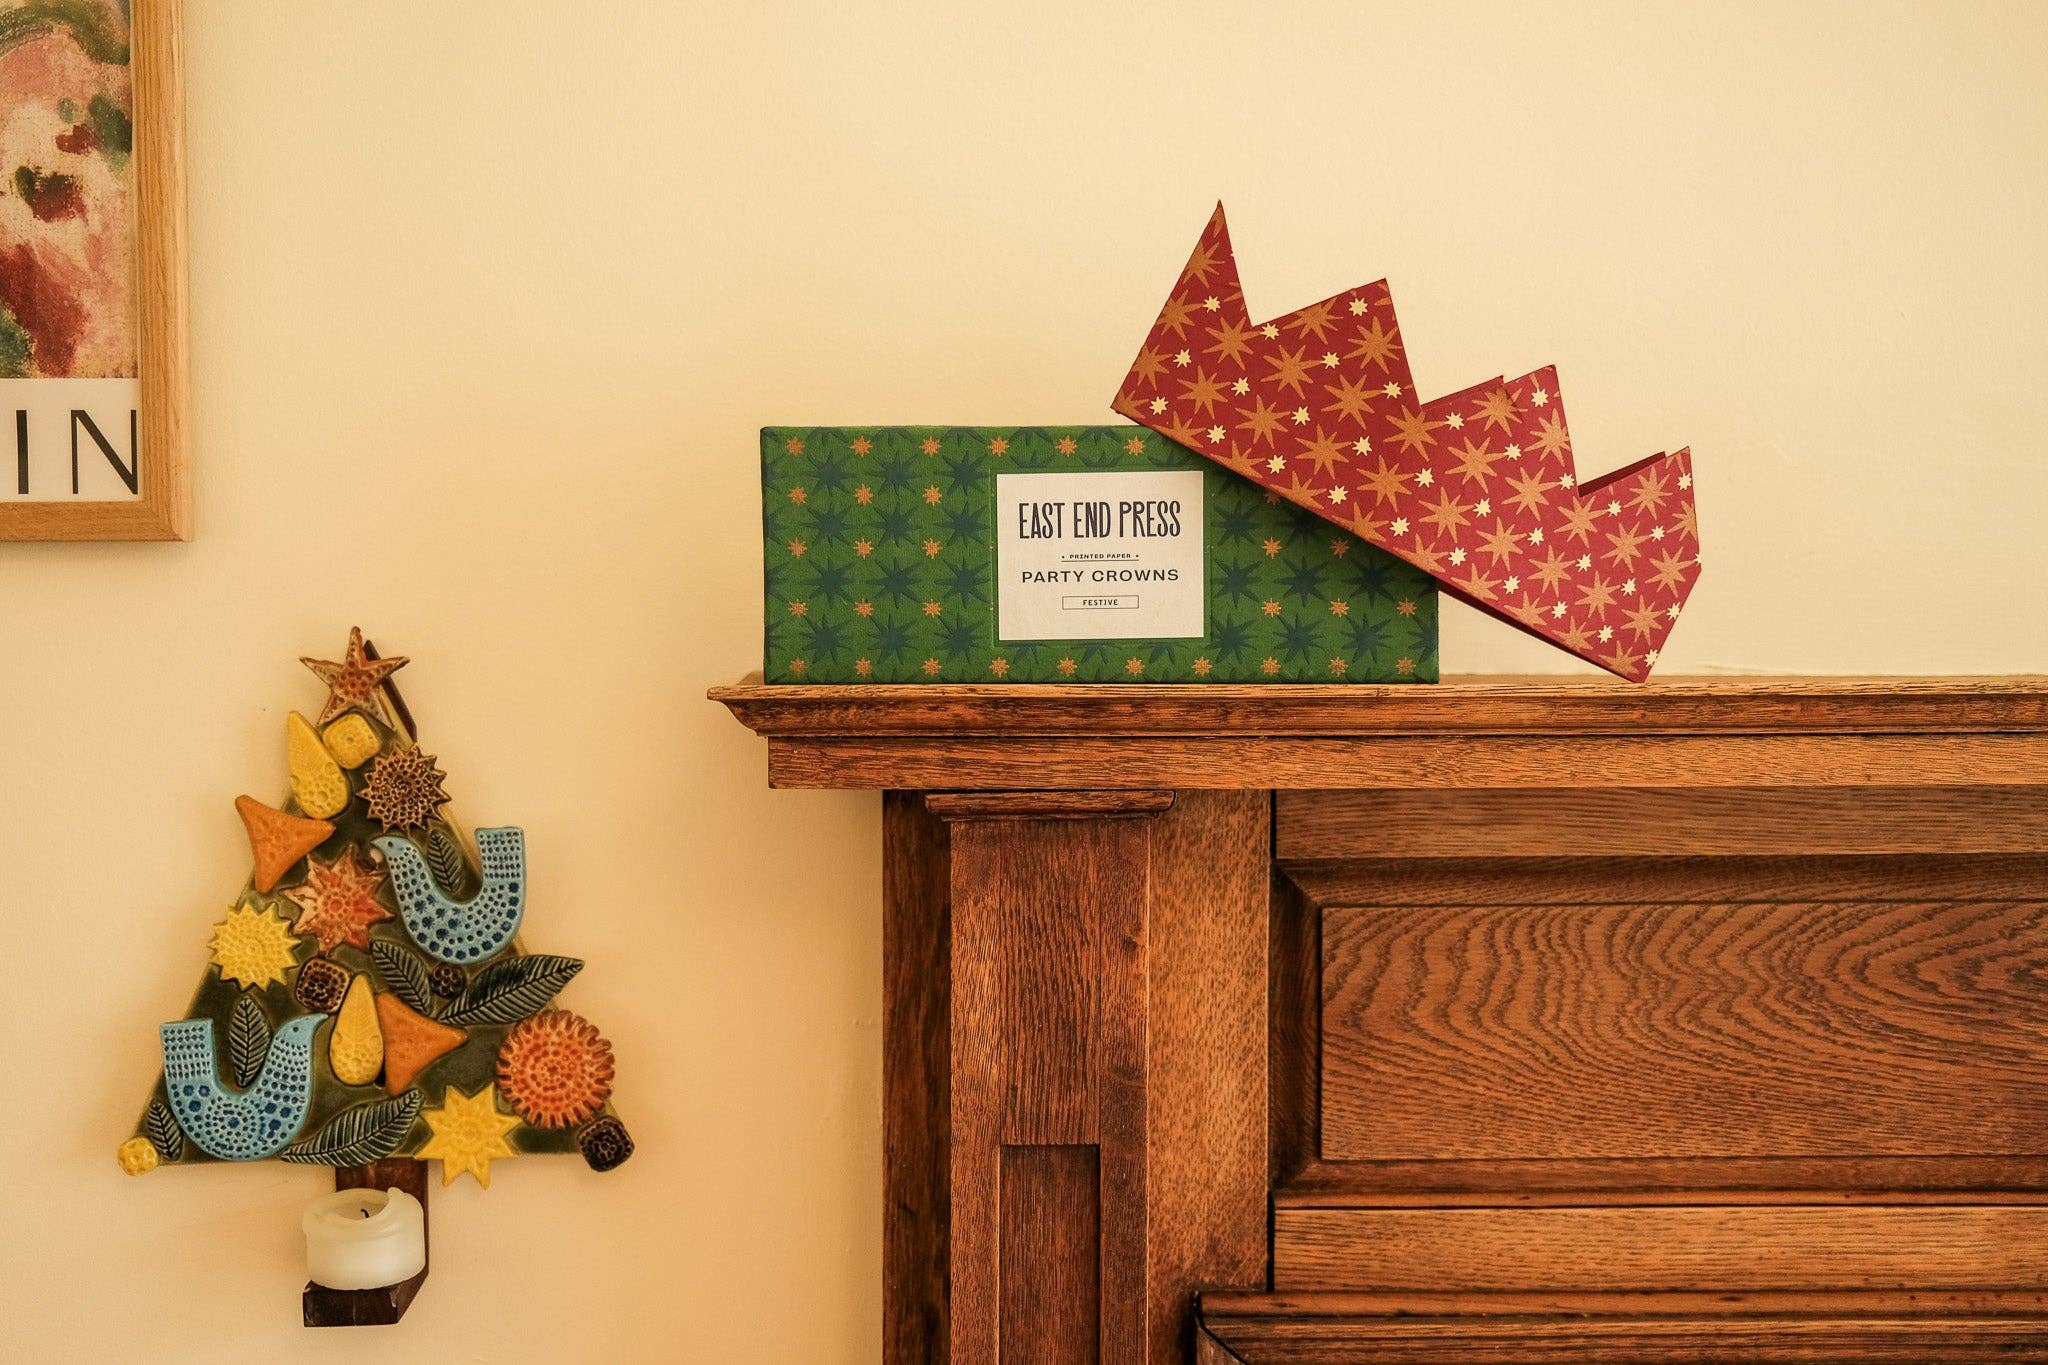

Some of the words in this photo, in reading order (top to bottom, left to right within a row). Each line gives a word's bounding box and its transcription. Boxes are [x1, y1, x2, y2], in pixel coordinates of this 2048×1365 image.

[1018, 502, 1065, 539] EAST
[1073, 501, 1111, 538] END
[1119, 500, 1181, 538] PRESS
[1021, 570, 1085, 583] PARTY
[1091, 568, 1179, 582] CROWNS
